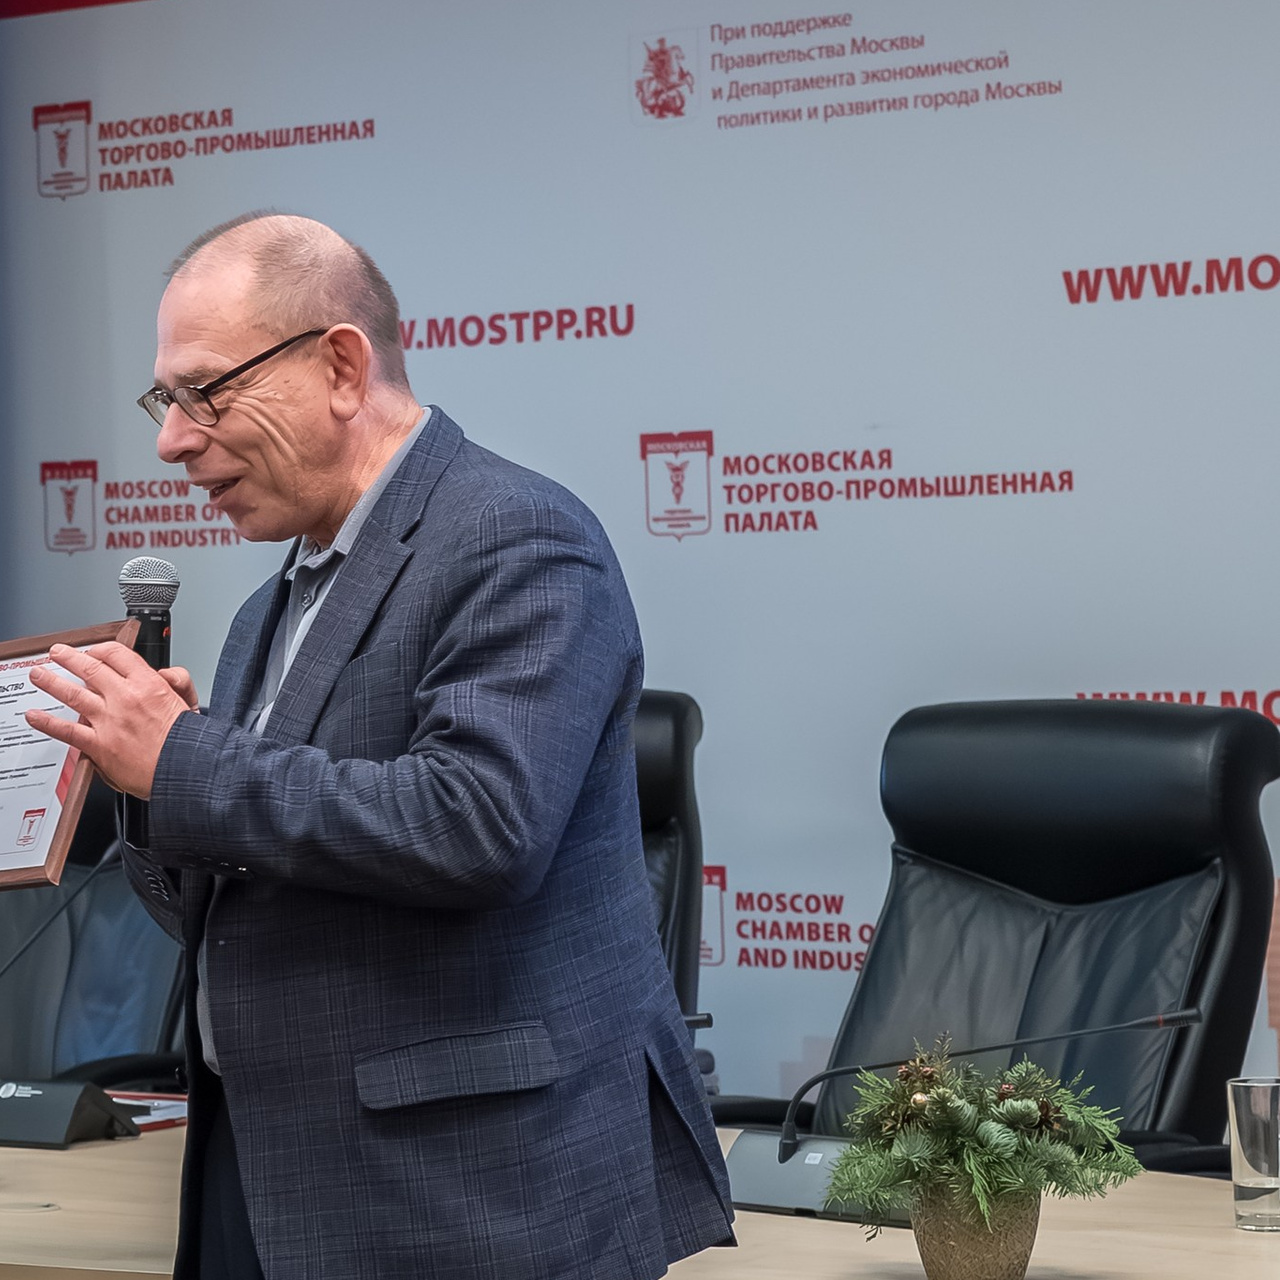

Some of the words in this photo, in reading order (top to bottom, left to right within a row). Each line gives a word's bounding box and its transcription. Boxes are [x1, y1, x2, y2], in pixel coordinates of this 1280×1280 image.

[710, 23, 746, 45] При
[750, 13, 853, 38] поддержке
[711, 44, 846, 74] Правительства
[850, 34, 925, 55] Москвы
[712, 87, 723, 100] и
[727, 72, 856, 103] Департамента
[861, 50, 1009, 85] экономической
[717, 107, 802, 129] политики
[807, 106, 818, 119] и
[823, 96, 908, 123] развития
[913, 89, 980, 111] города
[985, 80, 1062, 101] Москвы
[98, 109, 233, 141] МОСКОВСКАЯ
[99, 119, 375, 166] ТОРГОВО-ПРОМЫШЛЕННАЯ
[99, 167, 174, 192] ПАЛАТА
[1062, 254, 1280, 304] WWW.MO
[399, 303, 635, 350] .MOSTPP.RU
[723, 449, 892, 476] МОСКОВСКАЯ
[104, 480, 189, 500] MOSCOW
[723, 470, 1074, 505] ТОРГОВО-ПРОМЫШЛЕННАЯ
[105, 504, 196, 524] CHAMBER
[724, 510, 818, 533] ПАЛАТА
[106, 531, 144, 549] AND
[736, 892, 844, 914] MOSCOW
[736, 920, 851, 943] CHAMBER
[858, 924, 875, 944] O
[737, 948, 787, 968] AND
[794, 950, 868, 972] INDUS
